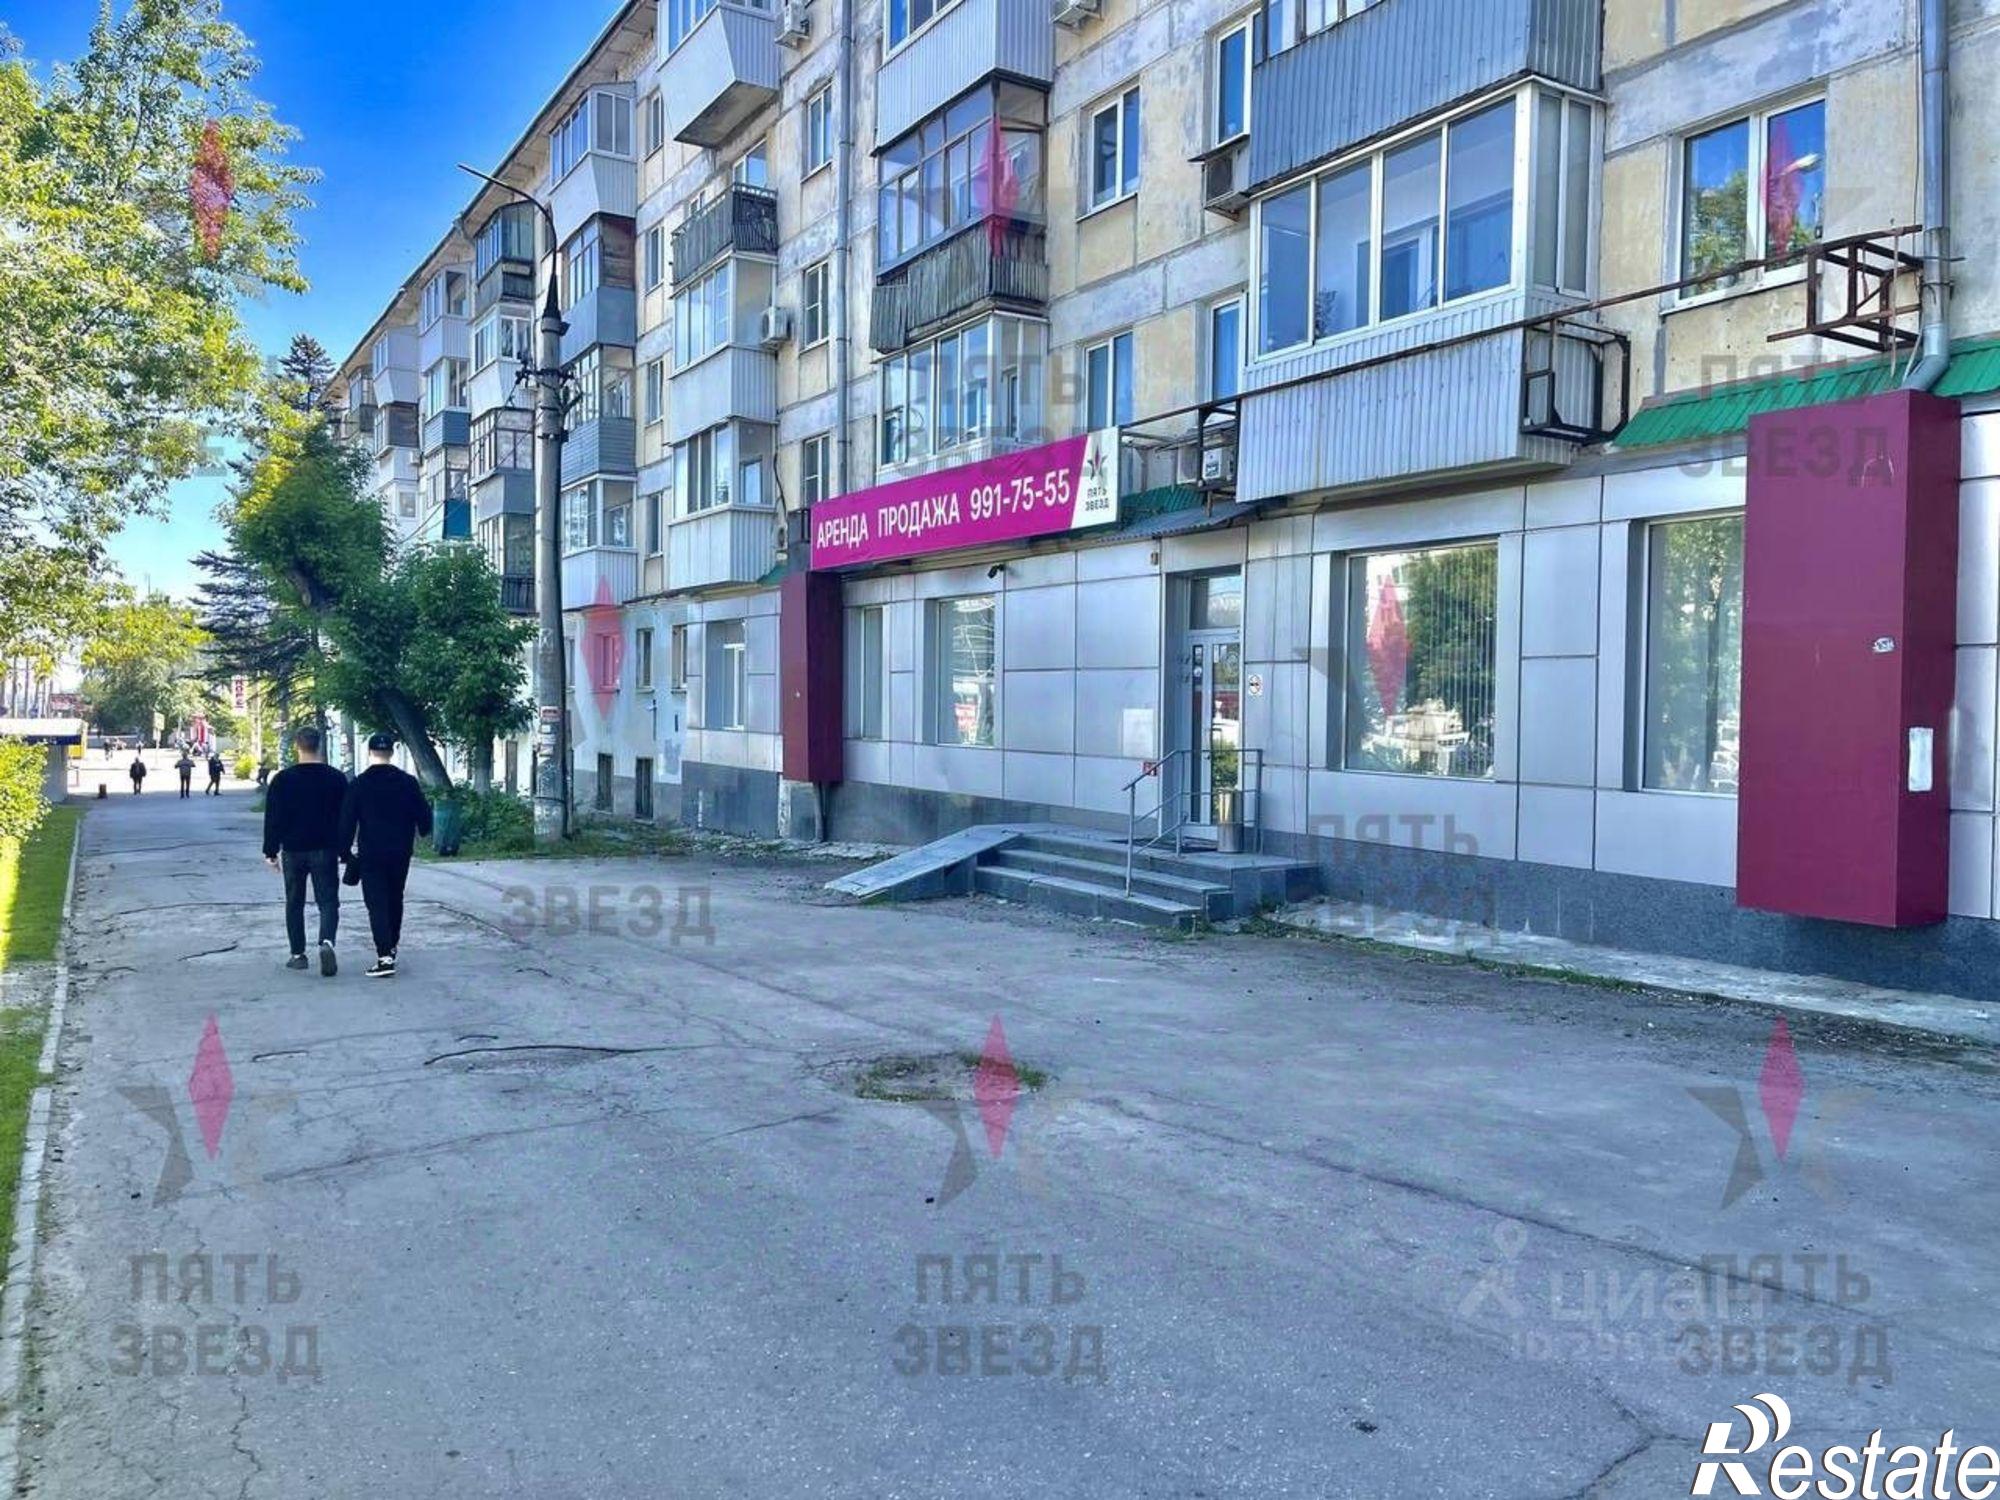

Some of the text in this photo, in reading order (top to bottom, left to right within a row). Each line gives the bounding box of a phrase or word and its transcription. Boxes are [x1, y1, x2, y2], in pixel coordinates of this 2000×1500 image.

[816, 467, 1070, 548] АРЕНДА ПРОДАЖА 991-75-55
[1086, 486, 1107, 499] ПЯТЬ
